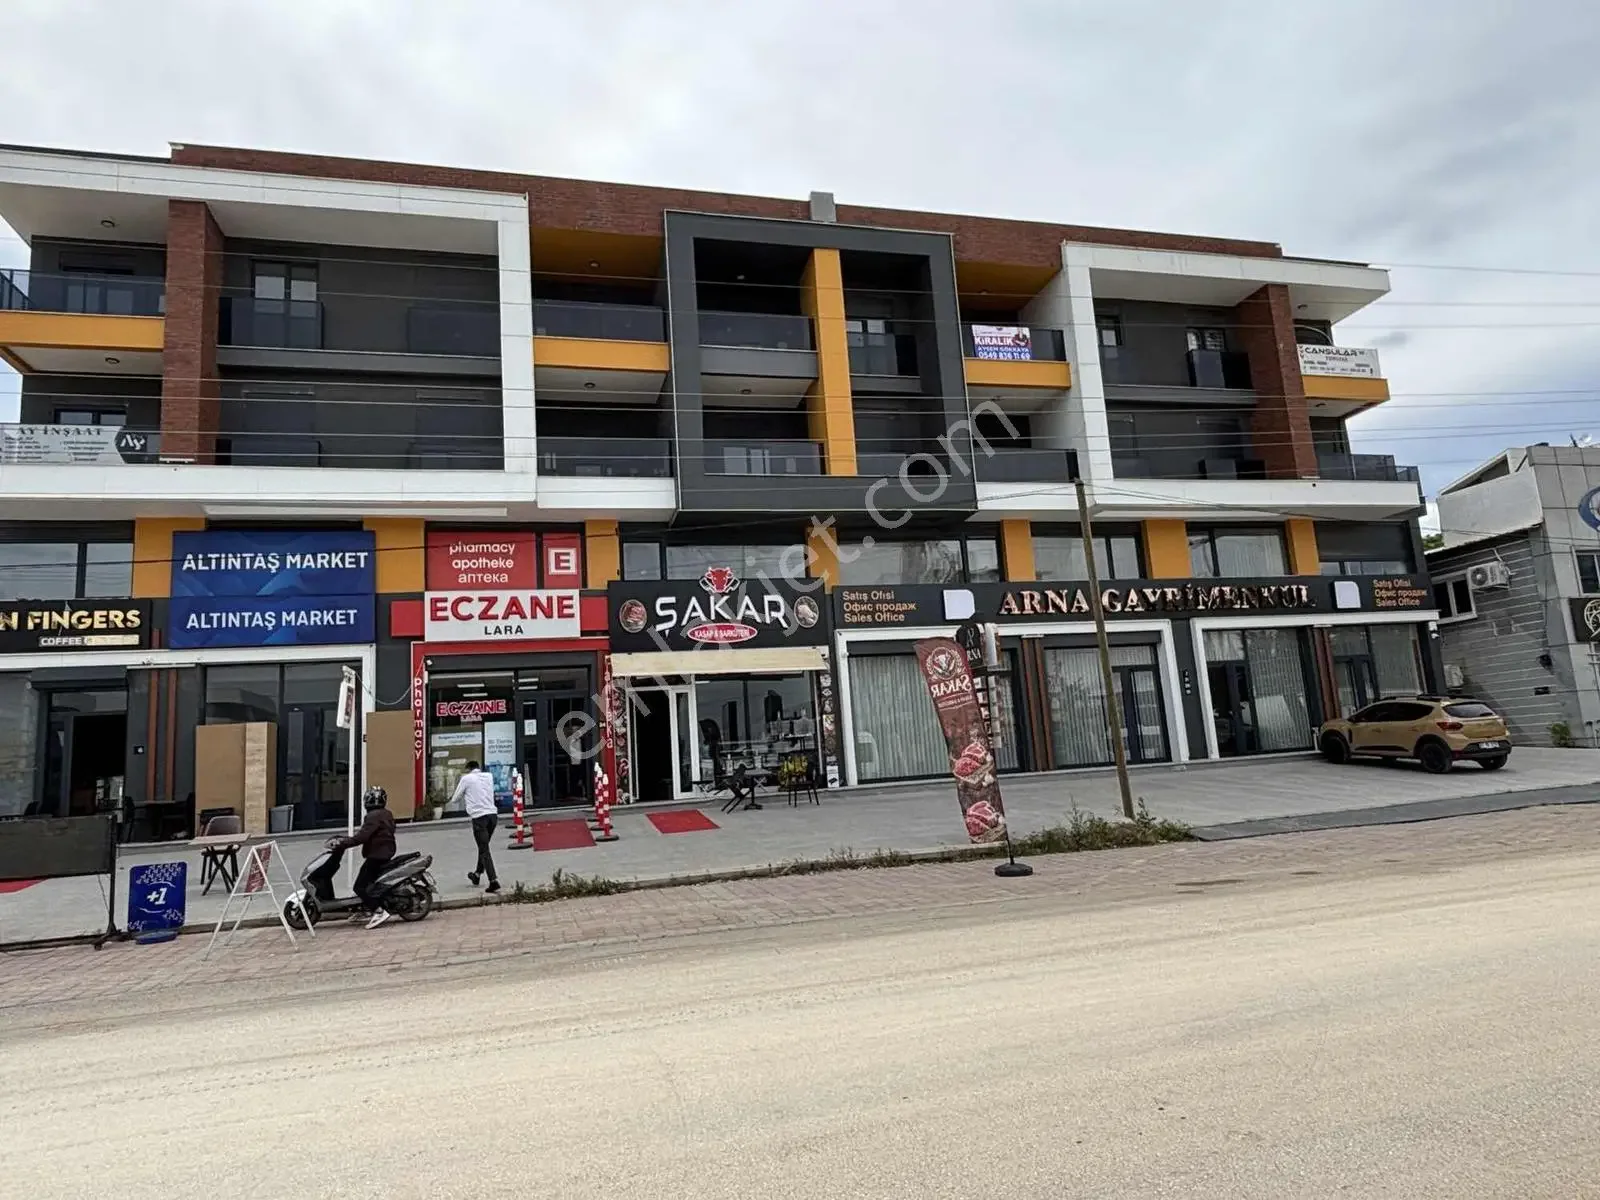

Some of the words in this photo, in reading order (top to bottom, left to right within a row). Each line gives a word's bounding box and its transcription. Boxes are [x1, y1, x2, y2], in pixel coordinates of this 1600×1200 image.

[449, 541, 515, 555] pharmacy
[182, 553, 280, 574] ALTINTAŞ
[286, 552, 368, 569] MARKET
[452, 557, 514, 571] apotheke
[554, 551, 572, 571] E
[458, 572, 509, 584] аптека
[842, 590, 868, 602] Satış
[871, 590, 895, 600] Ofisi
[999, 588, 1090, 615] ARNA
[430, 595, 576, 621] ECZANE
[655, 594, 789, 638] ŞAKAR
[843, 602, 873, 613] Офис
[876, 602, 917, 613] продаж
[27, 609, 141, 630] FINGERS
[186, 611, 276, 630] ALTINTAŞ
[282, 609, 357, 627] MARKET
[844, 612, 873, 623] Sales
[875, 612, 905, 622] Office
[484, 625, 524, 635] LARA
[41, 636, 82, 646] COFFEE
[436, 699, 507, 716] ECZANE
[414, 677, 424, 760] pharmacy
[147, 887, 167, 905] +1
